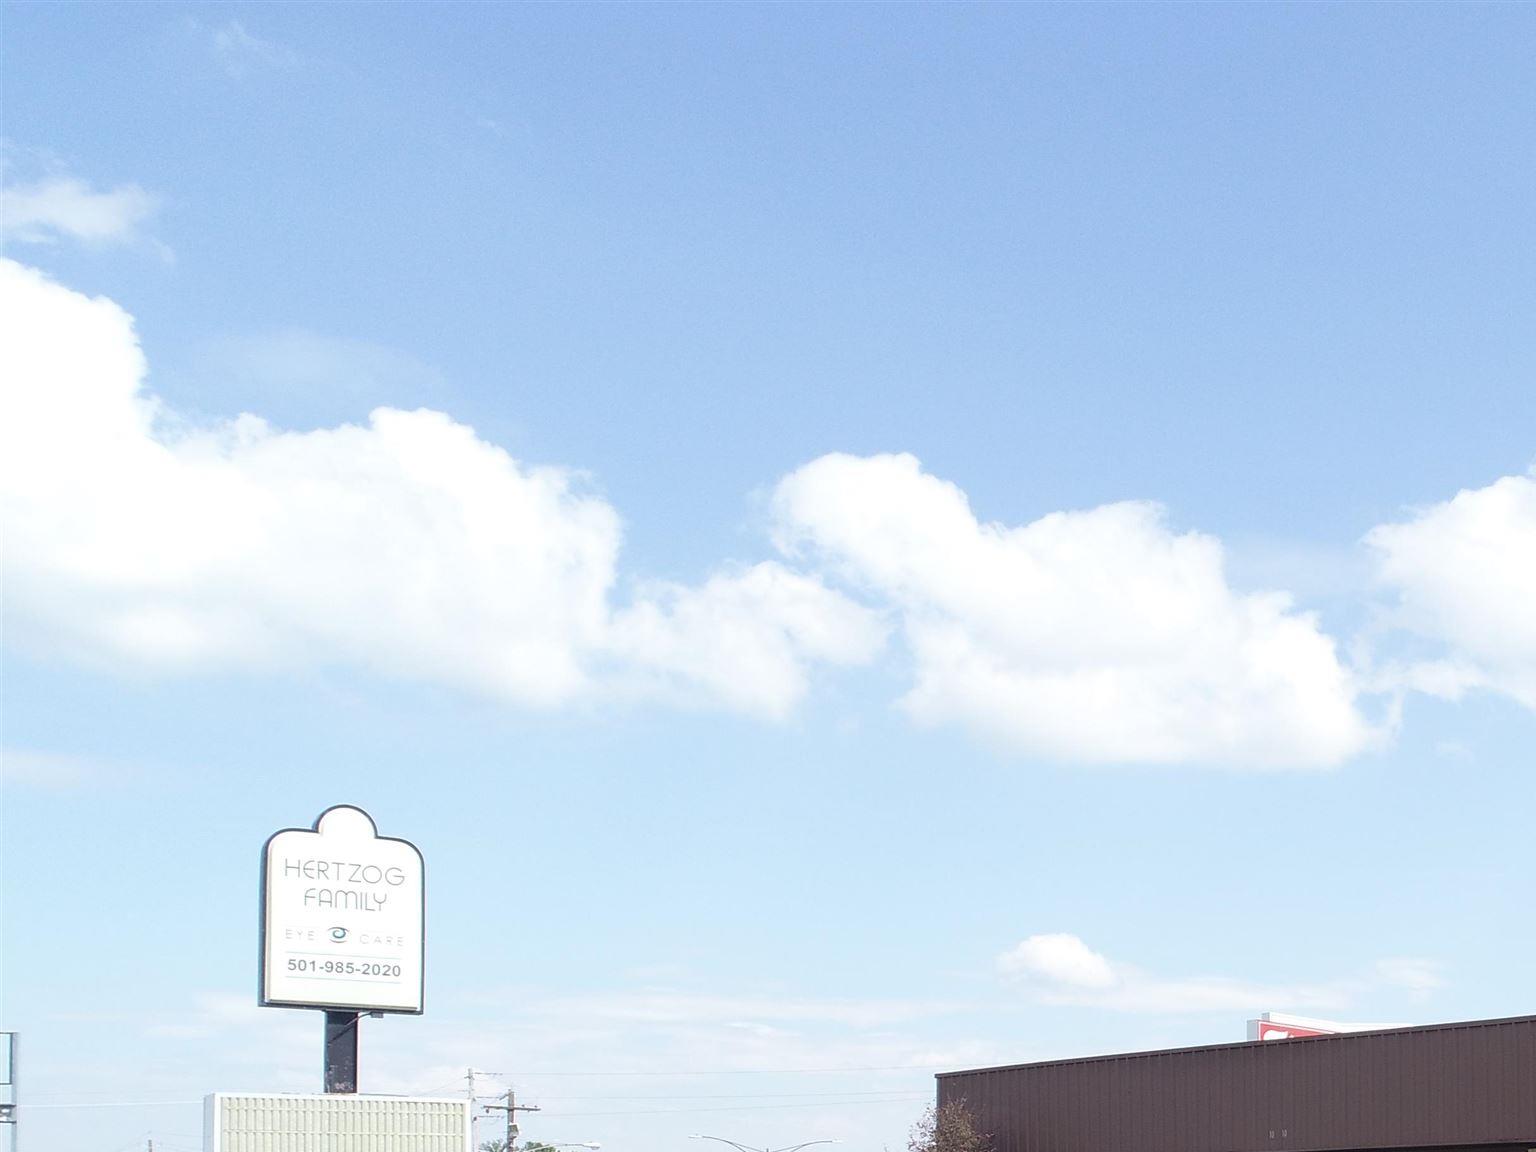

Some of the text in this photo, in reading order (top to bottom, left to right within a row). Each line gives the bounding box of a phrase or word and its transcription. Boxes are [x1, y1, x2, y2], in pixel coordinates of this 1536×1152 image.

[284, 858, 406, 886] HERTZOG
[304, 887, 388, 912] FAMILY
[285, 928, 404, 947] EYE CARE
[287, 958, 402, 977] 501-985-2020
